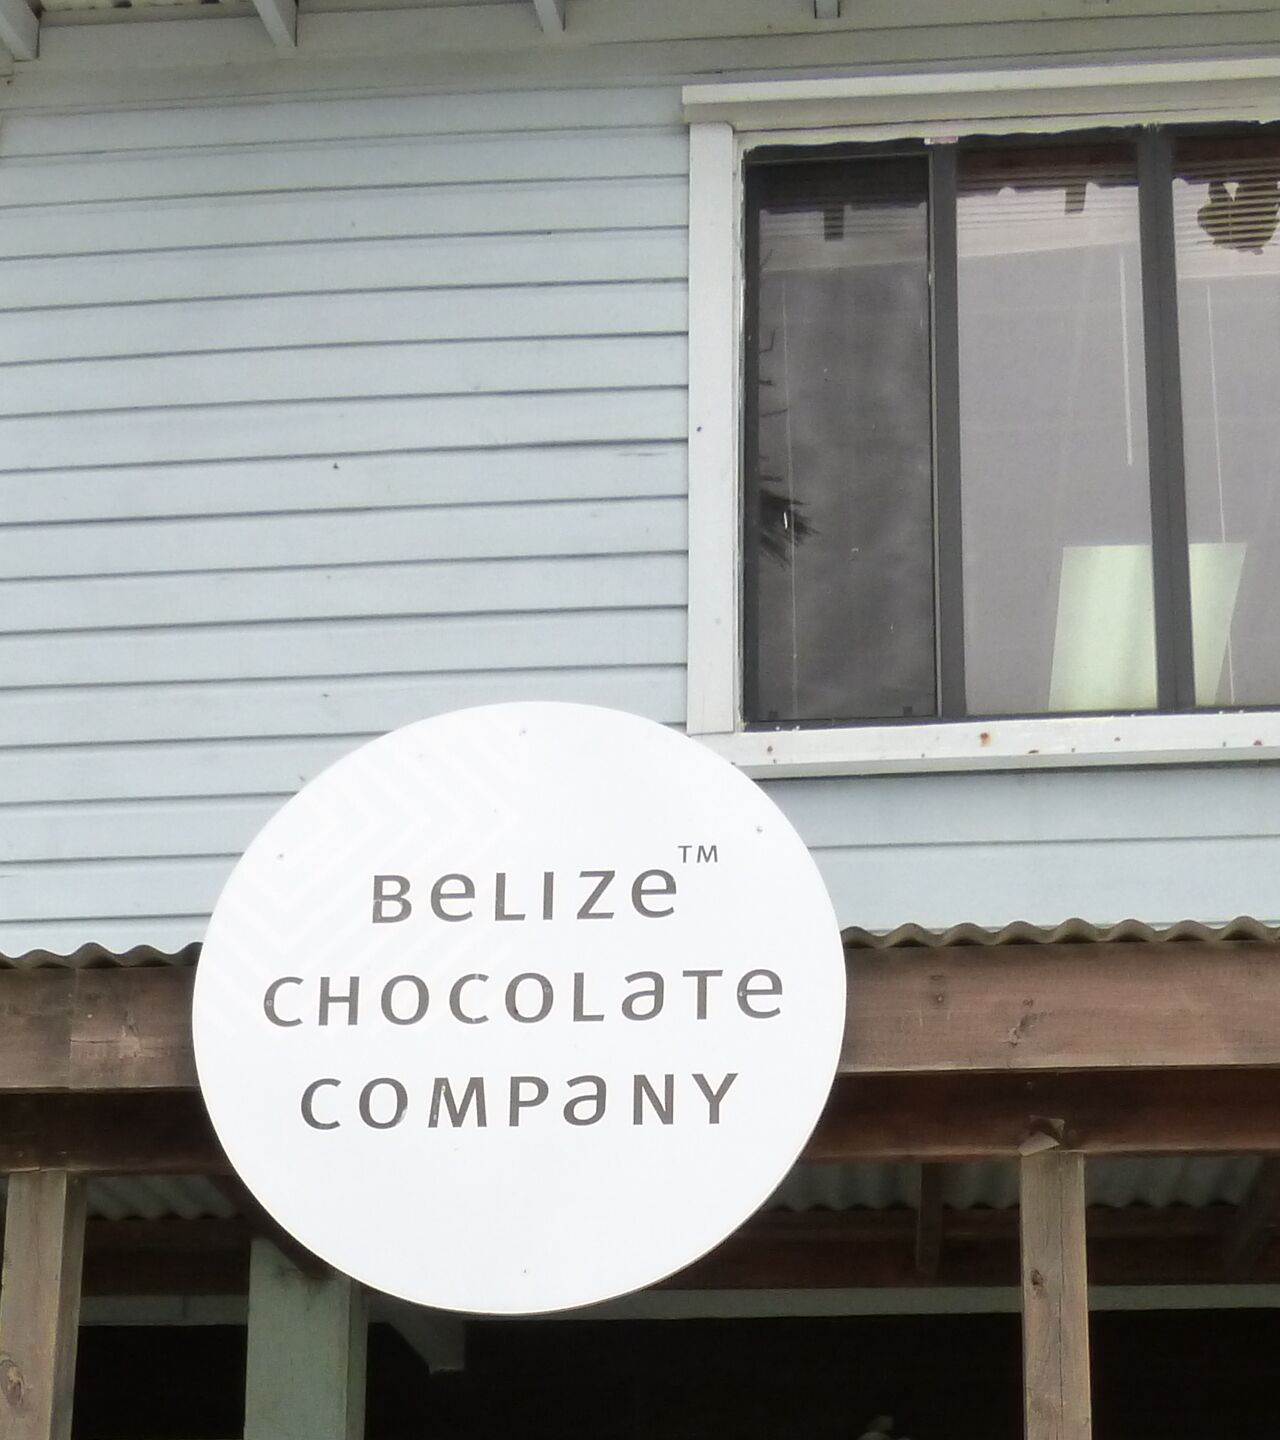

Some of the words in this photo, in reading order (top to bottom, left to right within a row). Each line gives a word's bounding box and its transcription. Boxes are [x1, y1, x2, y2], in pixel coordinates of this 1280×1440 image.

[371, 868, 677, 924] BeLIZe
[263, 967, 783, 1027] CHOCOLaTe
[300, 1072, 739, 1130] COMPaNY
